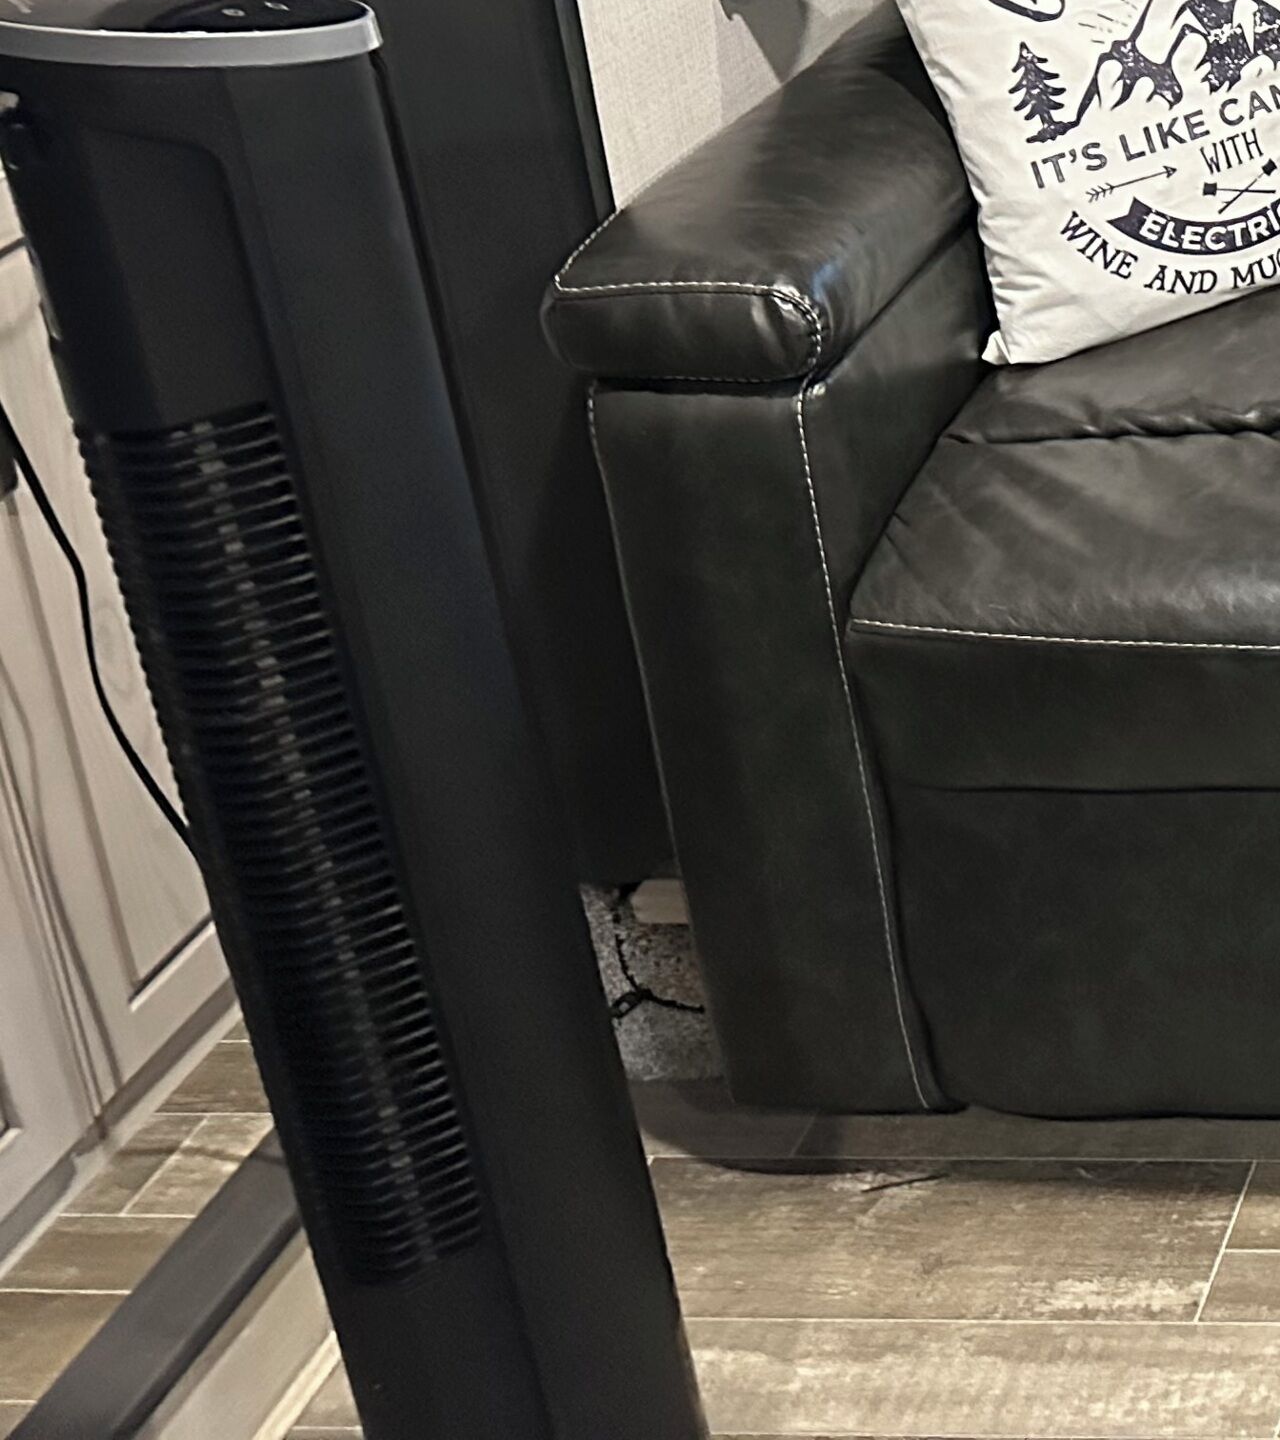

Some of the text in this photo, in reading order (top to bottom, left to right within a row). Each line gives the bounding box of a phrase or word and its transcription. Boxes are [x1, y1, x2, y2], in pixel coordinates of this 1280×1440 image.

[1030, 141, 1107, 189] IT'S
[1120, 110, 1210, 164] LIKE
[1200, 133, 1263, 175] WITH
[1060, 211, 1138, 280] WINE
[1144, 264, 1218, 296] AND
